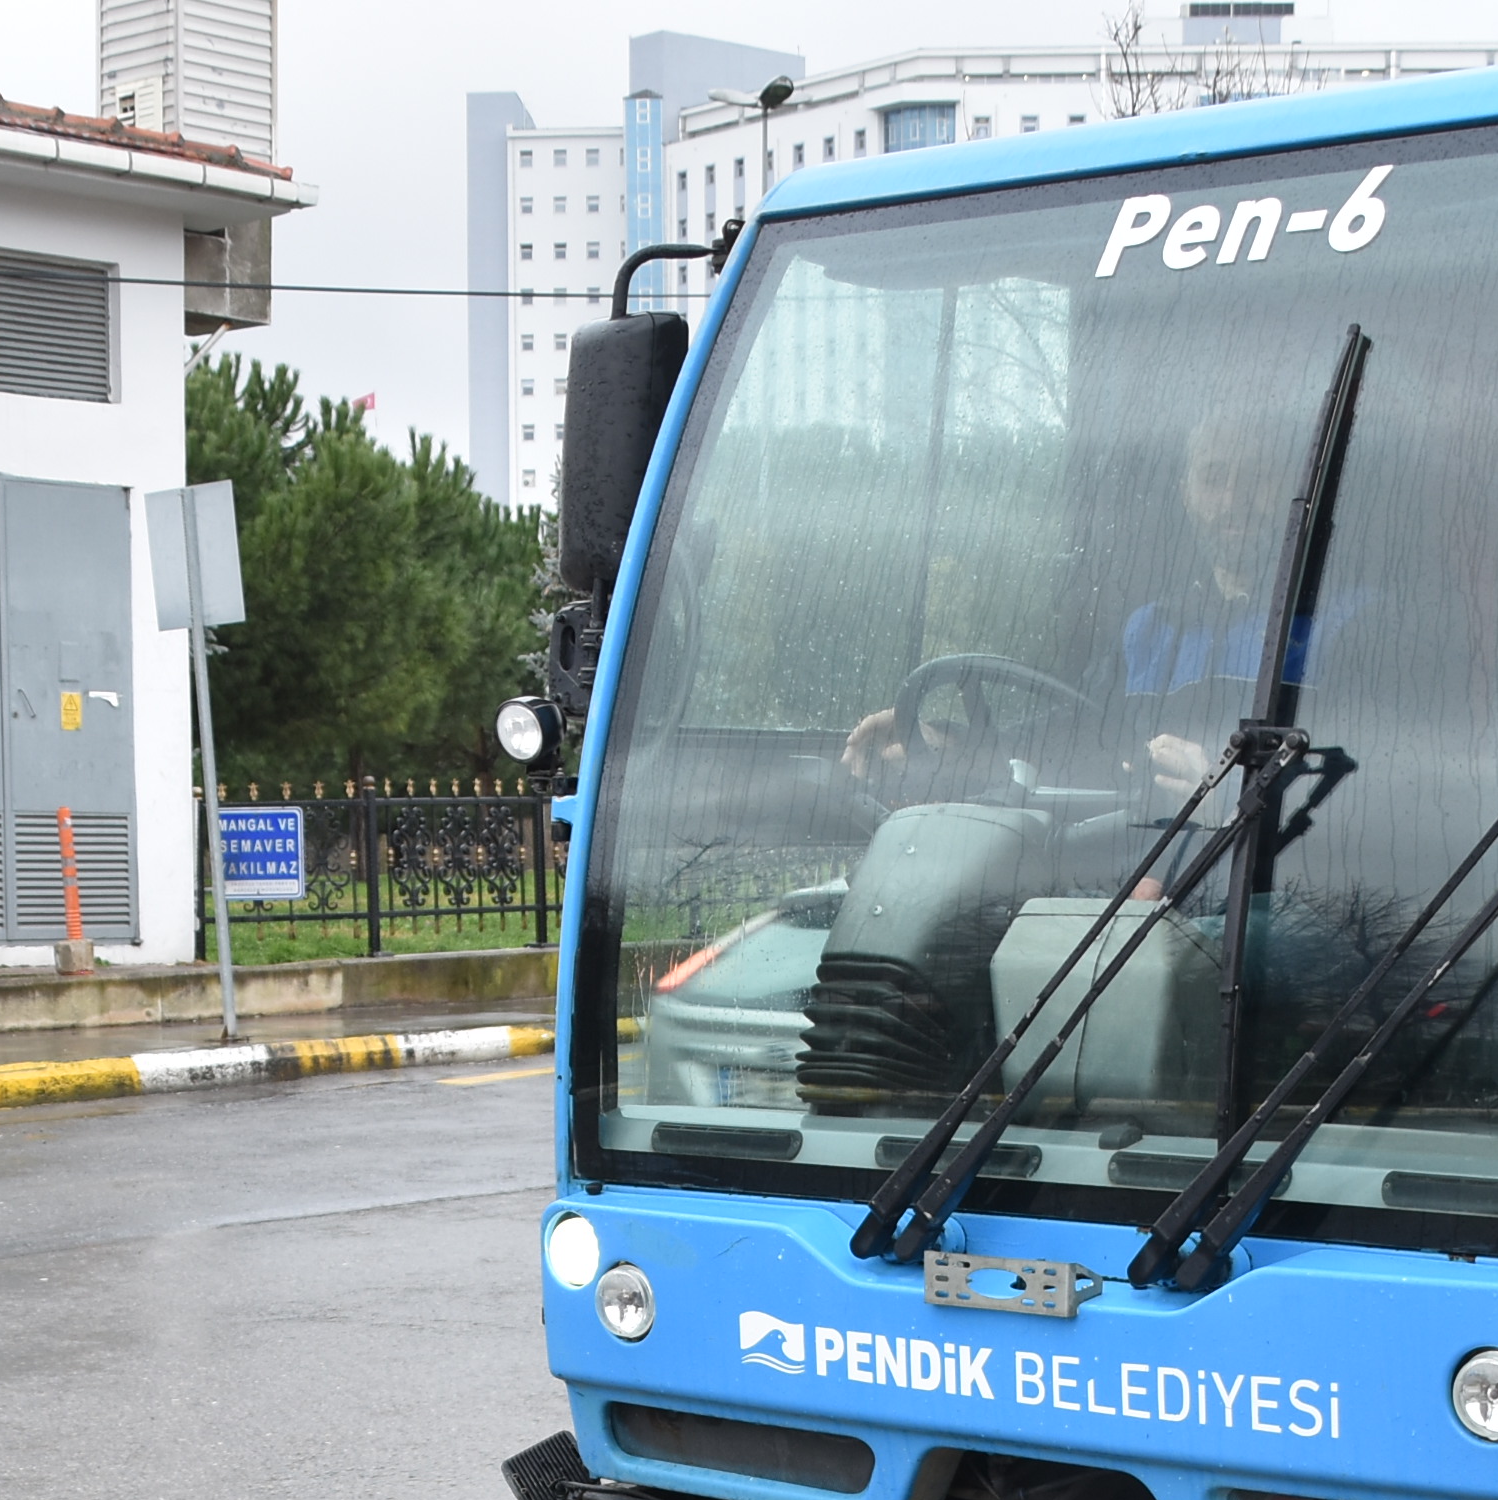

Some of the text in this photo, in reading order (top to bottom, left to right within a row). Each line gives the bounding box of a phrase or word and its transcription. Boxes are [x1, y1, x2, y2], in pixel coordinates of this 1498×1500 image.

[1095, 165, 1394, 278] Pen-6
[218, 817, 296, 832] MANGAL VE
[220, 839, 295, 853] SEMAVER
